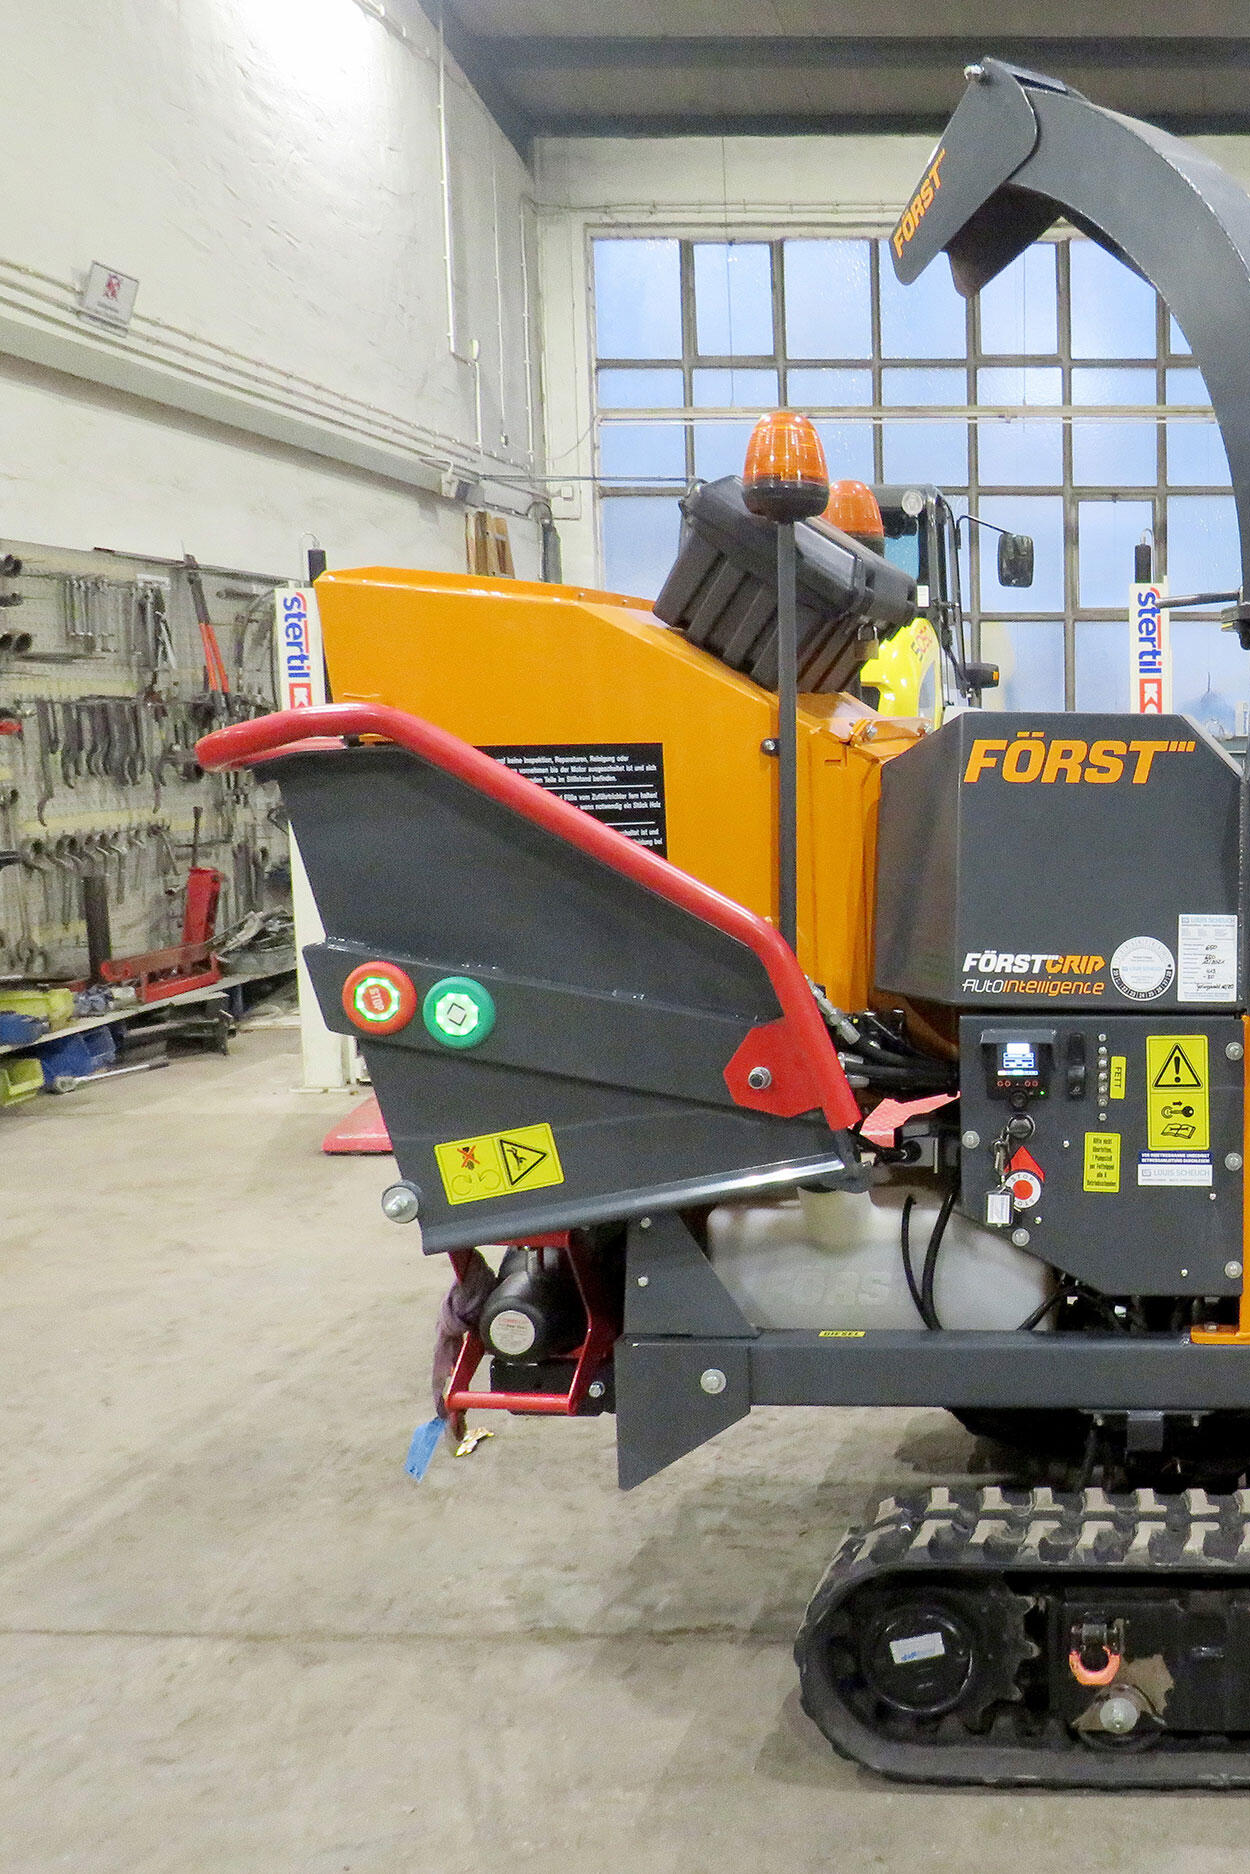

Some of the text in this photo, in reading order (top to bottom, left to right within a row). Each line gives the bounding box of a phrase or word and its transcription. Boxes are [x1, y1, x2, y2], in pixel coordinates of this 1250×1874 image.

[893, 148, 946, 259] FÖRST
[283, 592, 311, 678] stertil
[1138, 587, 1162, 673] stertil
[963, 731, 1196, 784] FÖRST
[369, 987, 385, 1011] STOP
[1114, 1066, 1122, 1089] FETT
